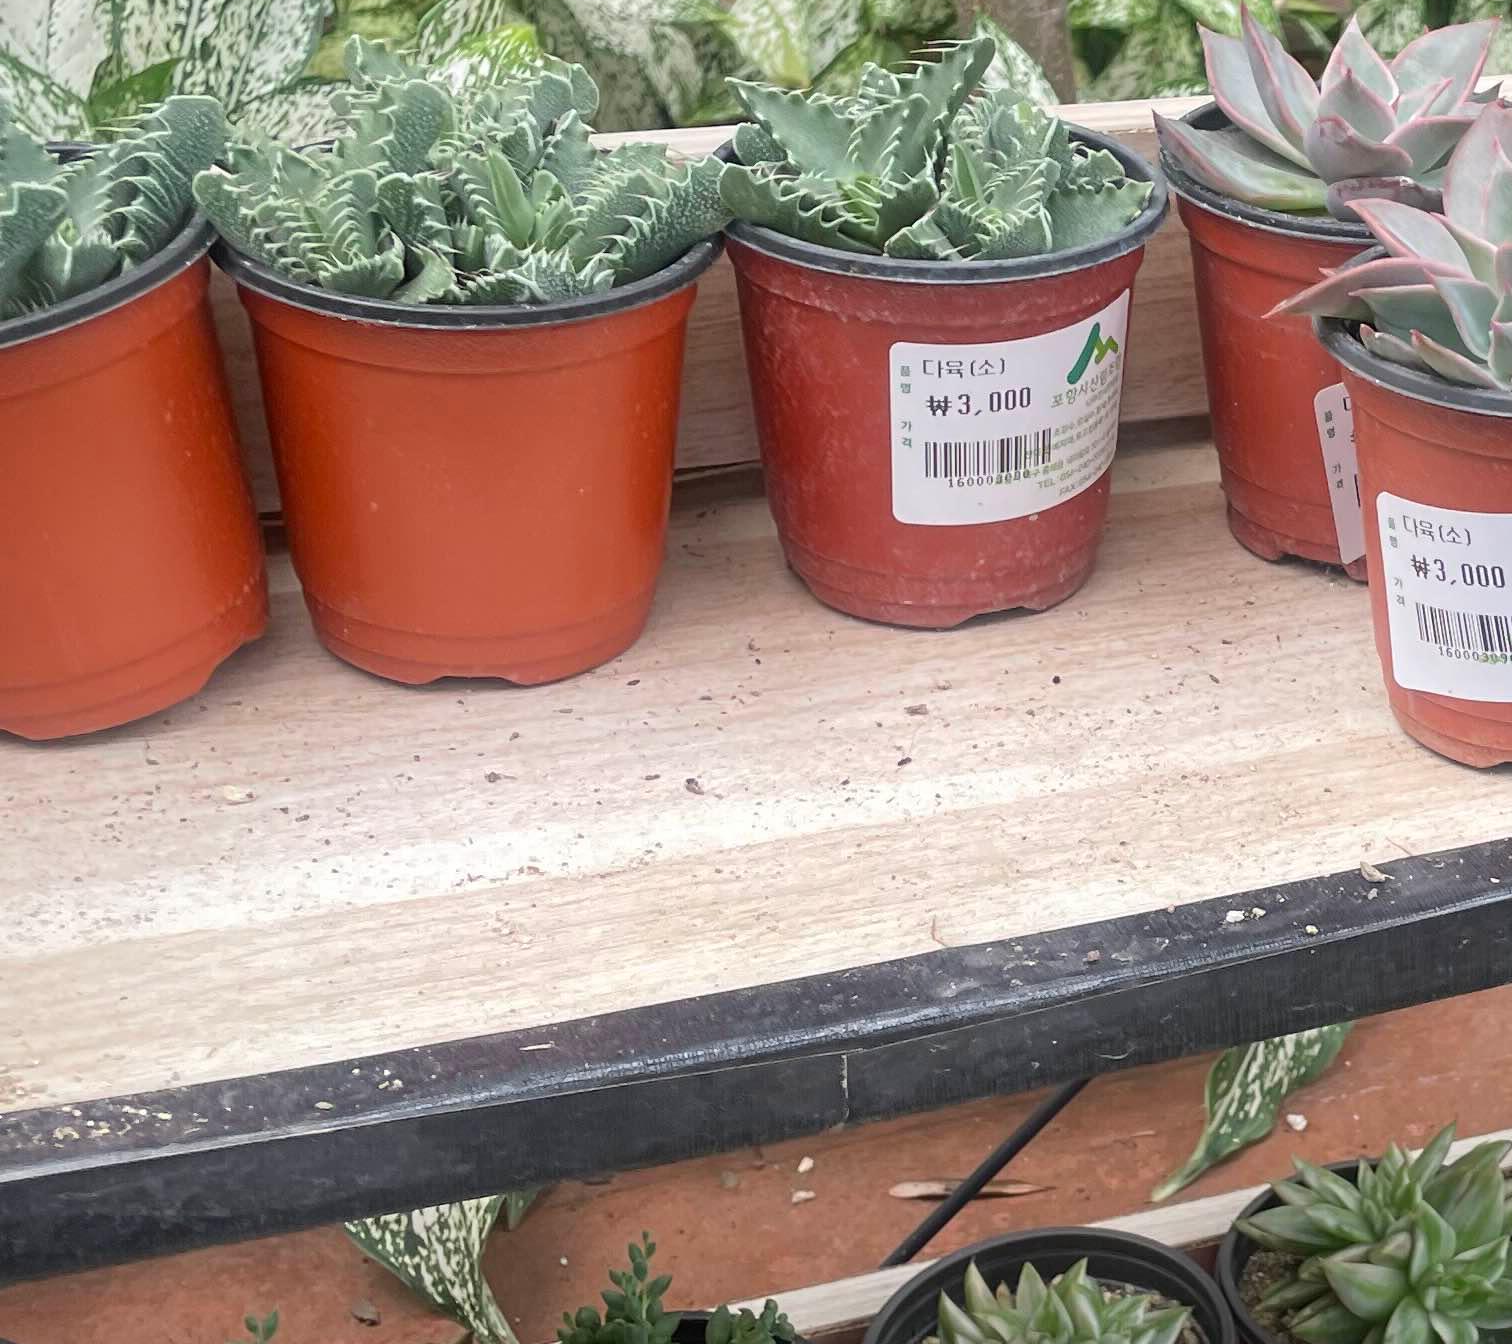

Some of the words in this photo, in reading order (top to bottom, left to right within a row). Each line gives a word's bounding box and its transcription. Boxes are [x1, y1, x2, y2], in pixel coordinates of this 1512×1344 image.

[922, 357, 1006, 379] 다육(소)
[925, 386, 1032, 417] ₩3,000
[1402, 514, 1472, 547] 다육(소)
[1410, 554, 1506, 589] ₩3,000
